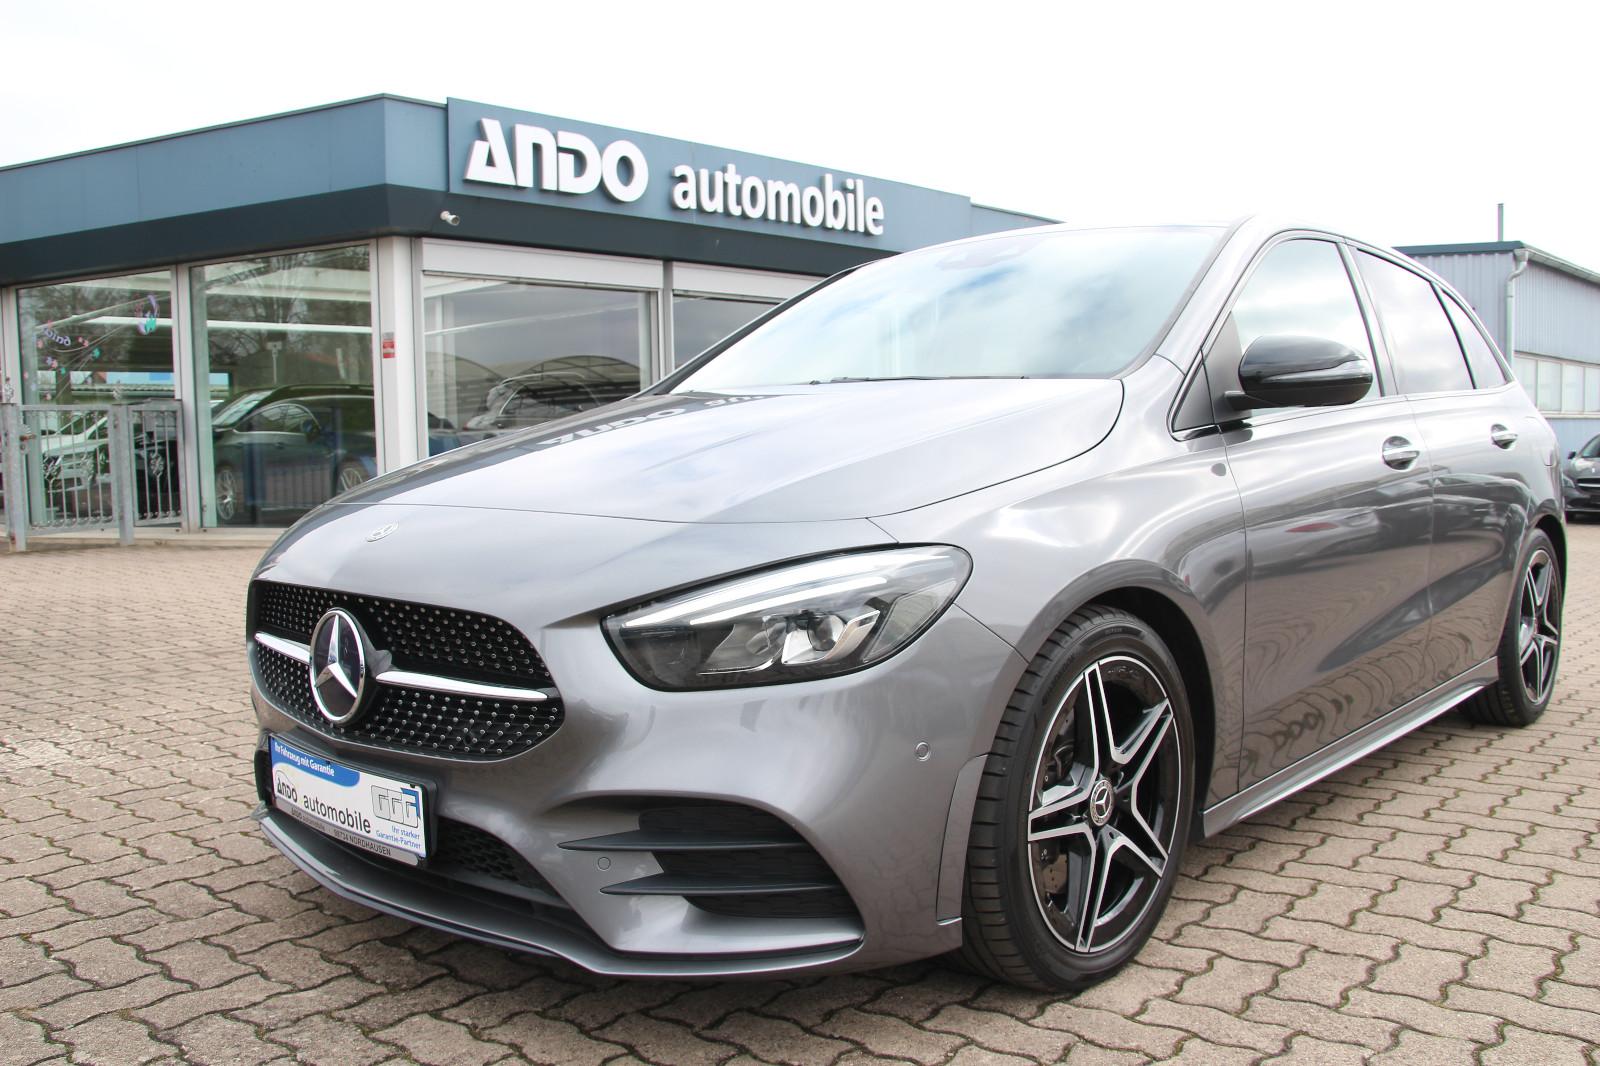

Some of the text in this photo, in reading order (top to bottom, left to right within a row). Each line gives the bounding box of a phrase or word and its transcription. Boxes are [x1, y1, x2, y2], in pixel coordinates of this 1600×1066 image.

[463, 117, 885, 236] ANDO automobile
[300, 756, 309, 768] mit
[309, 759, 335, 777] Garantie
[277, 778, 298, 803] ANDO
[304, 794, 371, 834] automobile
[349, 834, 392, 857] NORDHAUSEN
